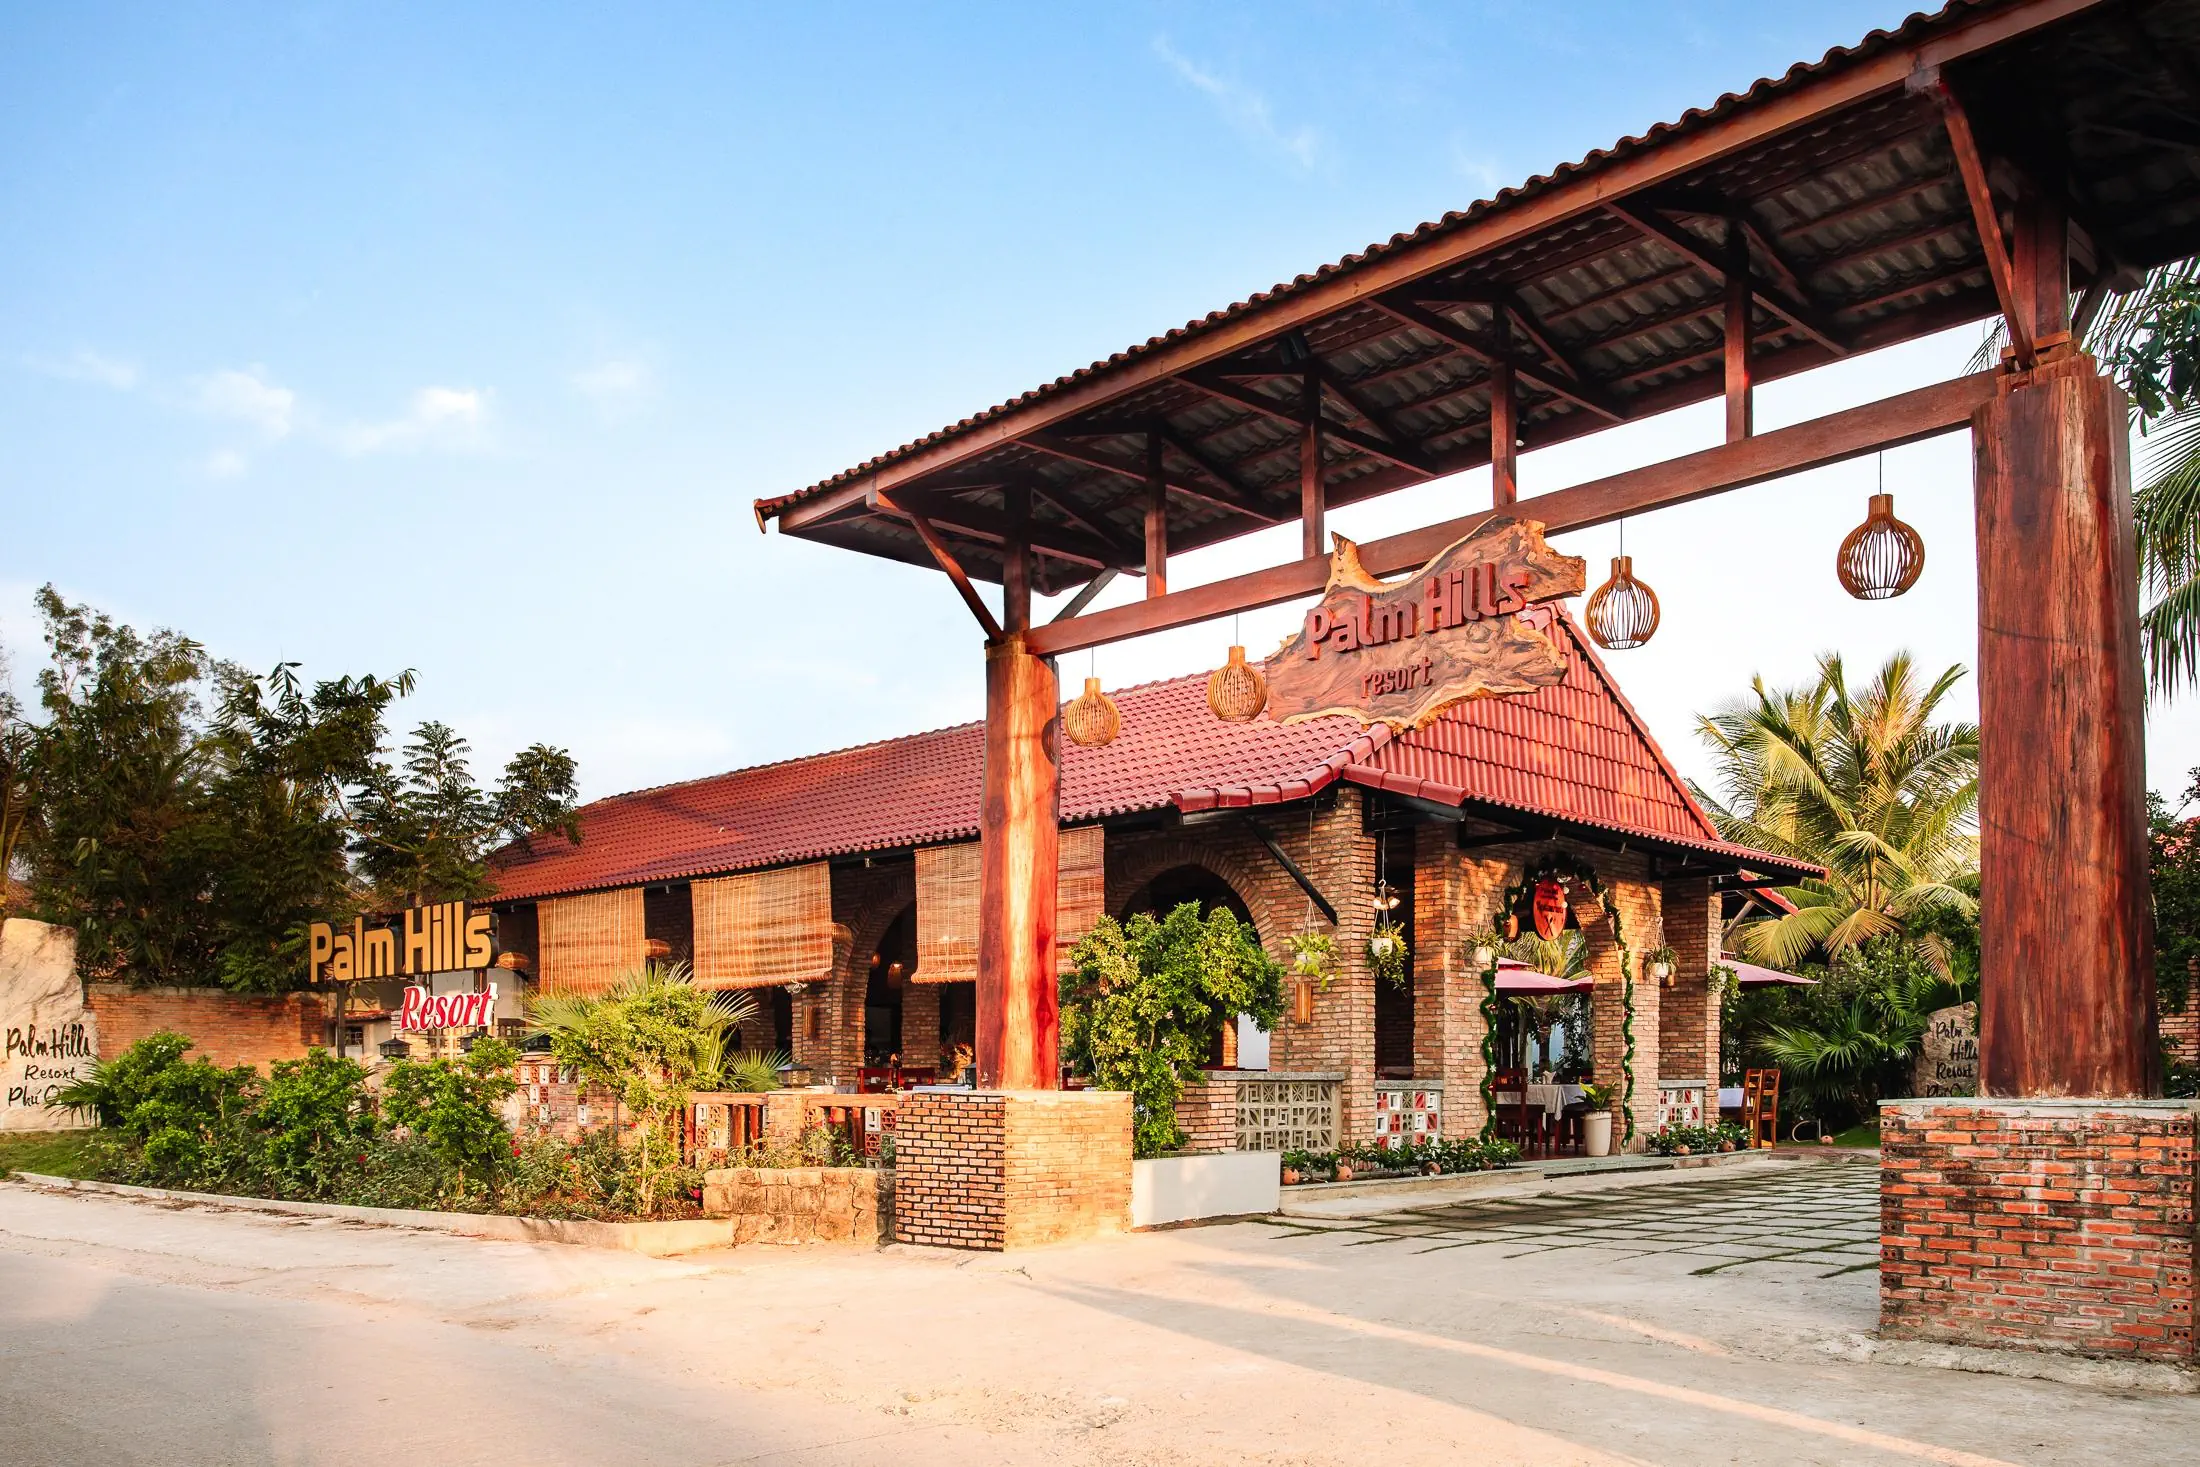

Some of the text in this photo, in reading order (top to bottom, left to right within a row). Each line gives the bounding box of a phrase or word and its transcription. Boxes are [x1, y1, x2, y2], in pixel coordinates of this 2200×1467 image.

[1305, 562, 1529, 660] Palm Hills
[1361, 657, 1433, 699] resort
[310, 901, 493, 983] Palm Hills
[401, 983, 495, 1031] Resort
[6, 1024, 90, 1059] Palm Hills
[1935, 1019, 1963, 1039] Palm
[1949, 1040, 1978, 1061] Hills
[25, 1064, 76, 1080] Resort
[1936, 1061, 1973, 1079] Resort
[8, 1085, 42, 1107] Phú
